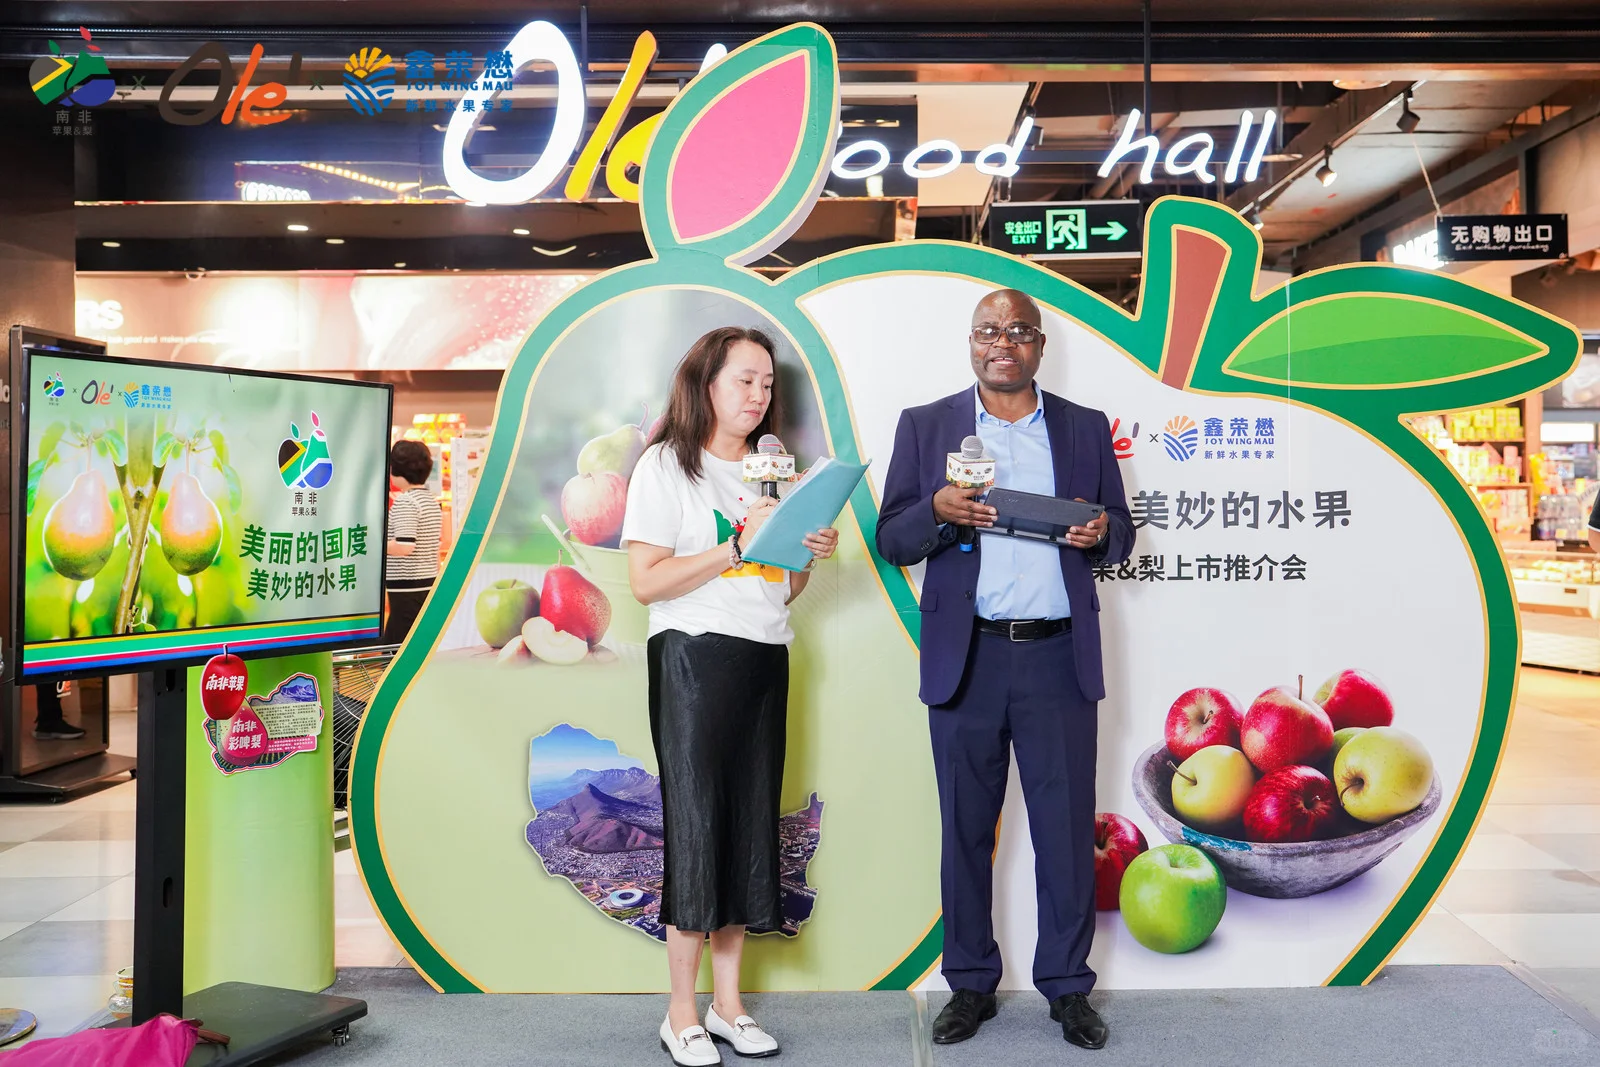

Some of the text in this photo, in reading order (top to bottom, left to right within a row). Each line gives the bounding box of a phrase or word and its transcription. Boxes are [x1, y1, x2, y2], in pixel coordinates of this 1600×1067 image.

[831, 116, 1034, 179] ood
[1097, 108, 1277, 184] hall
[1005, 221, 1042, 235] 安全出口
[1451, 225, 1552, 244] 无购物出口
[1012, 235, 1037, 244] EXIT
[1508, 242, 1550, 253] purchasing
[1203, 417, 1275, 437] 鑫荣懋
[1204, 450, 1275, 460] 新鲜水果专家
[294, 492, 317, 505] 南非
[292, 507, 317, 516] 苹果&梨
[1131, 490, 1352, 531] 美妙的水果
[239, 523, 368, 565] 美丽的国度
[246, 564, 357, 601] 美妙的水果
[205, 674, 245, 691] 南非苹果
[232, 718, 257, 733] 南非
[228, 733, 263, 751] 彩啤梨
